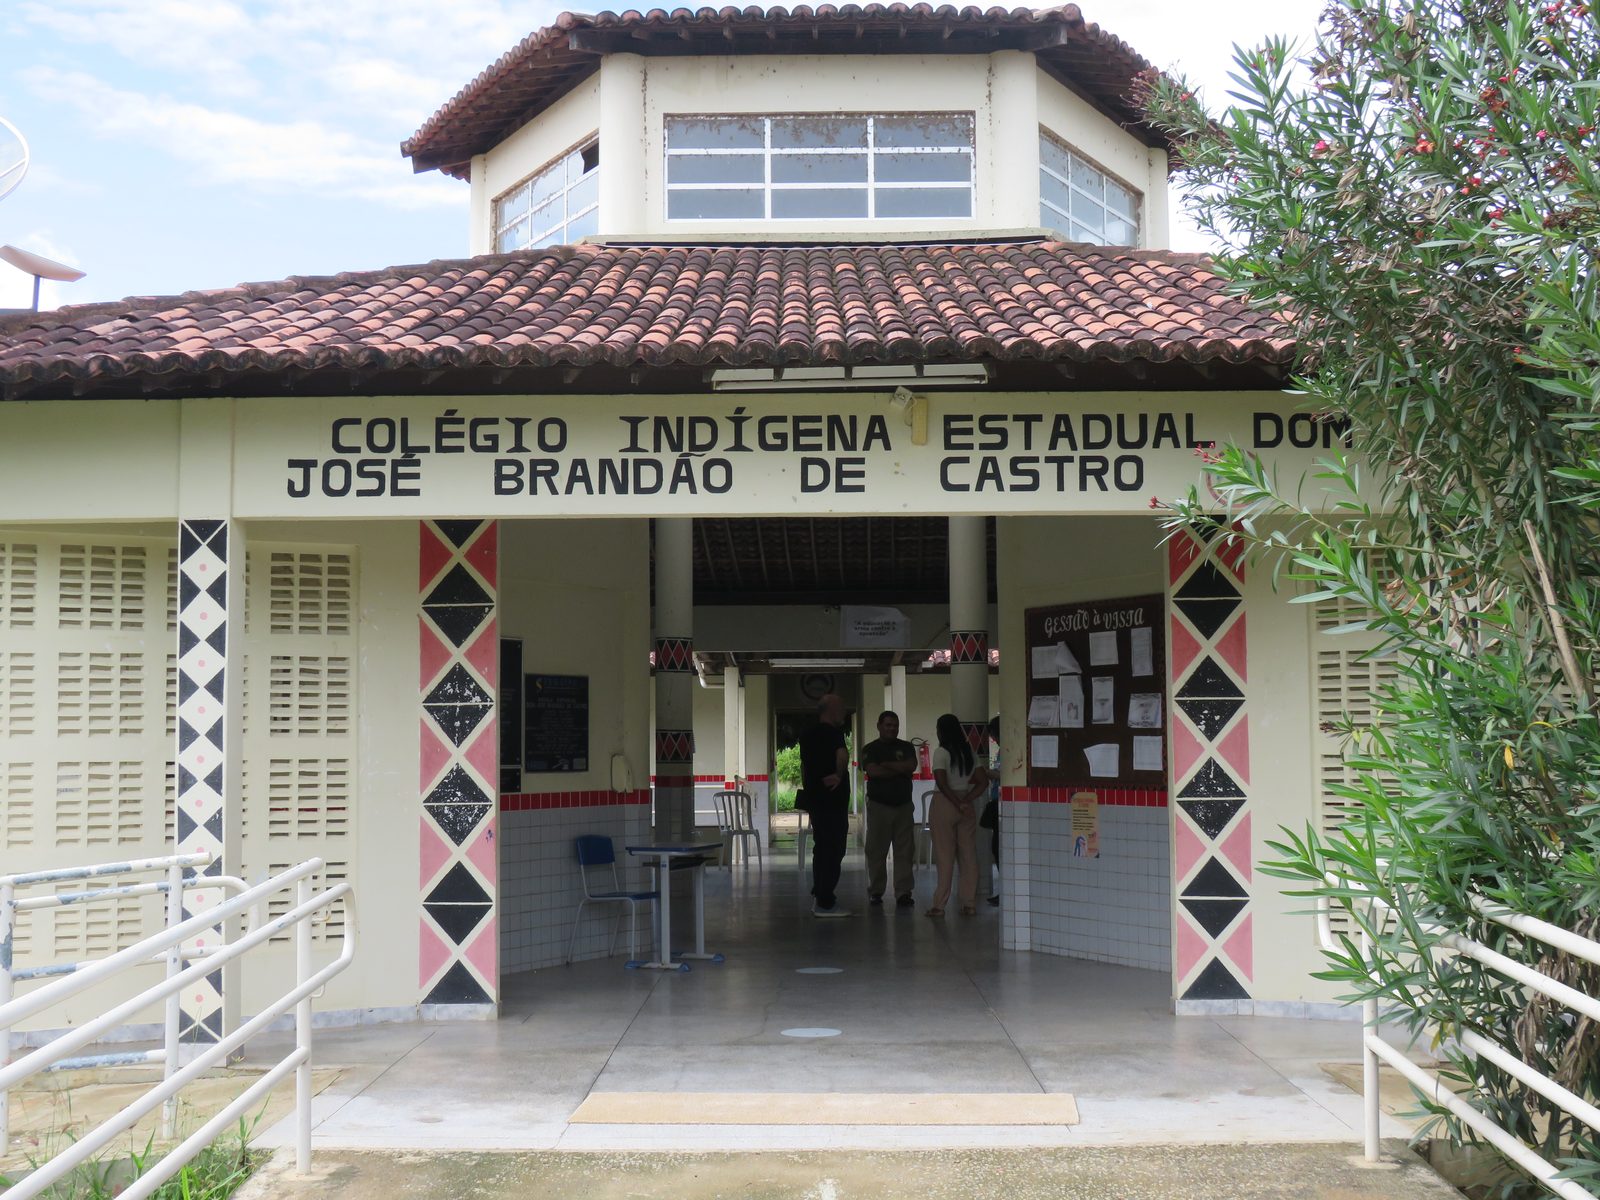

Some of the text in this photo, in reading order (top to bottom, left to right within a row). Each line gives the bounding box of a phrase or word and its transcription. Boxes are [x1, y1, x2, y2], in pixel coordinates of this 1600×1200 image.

[332, 406, 1353, 454] COLÉGIO INDÍGENA ESTADUAL DOM
[287, 452, 1144, 498] JOSÉ BRANDÃO DE CASTRO
[1044, 609, 1090, 638] GESTÃO
[1102, 608, 1145, 630] VISTA
